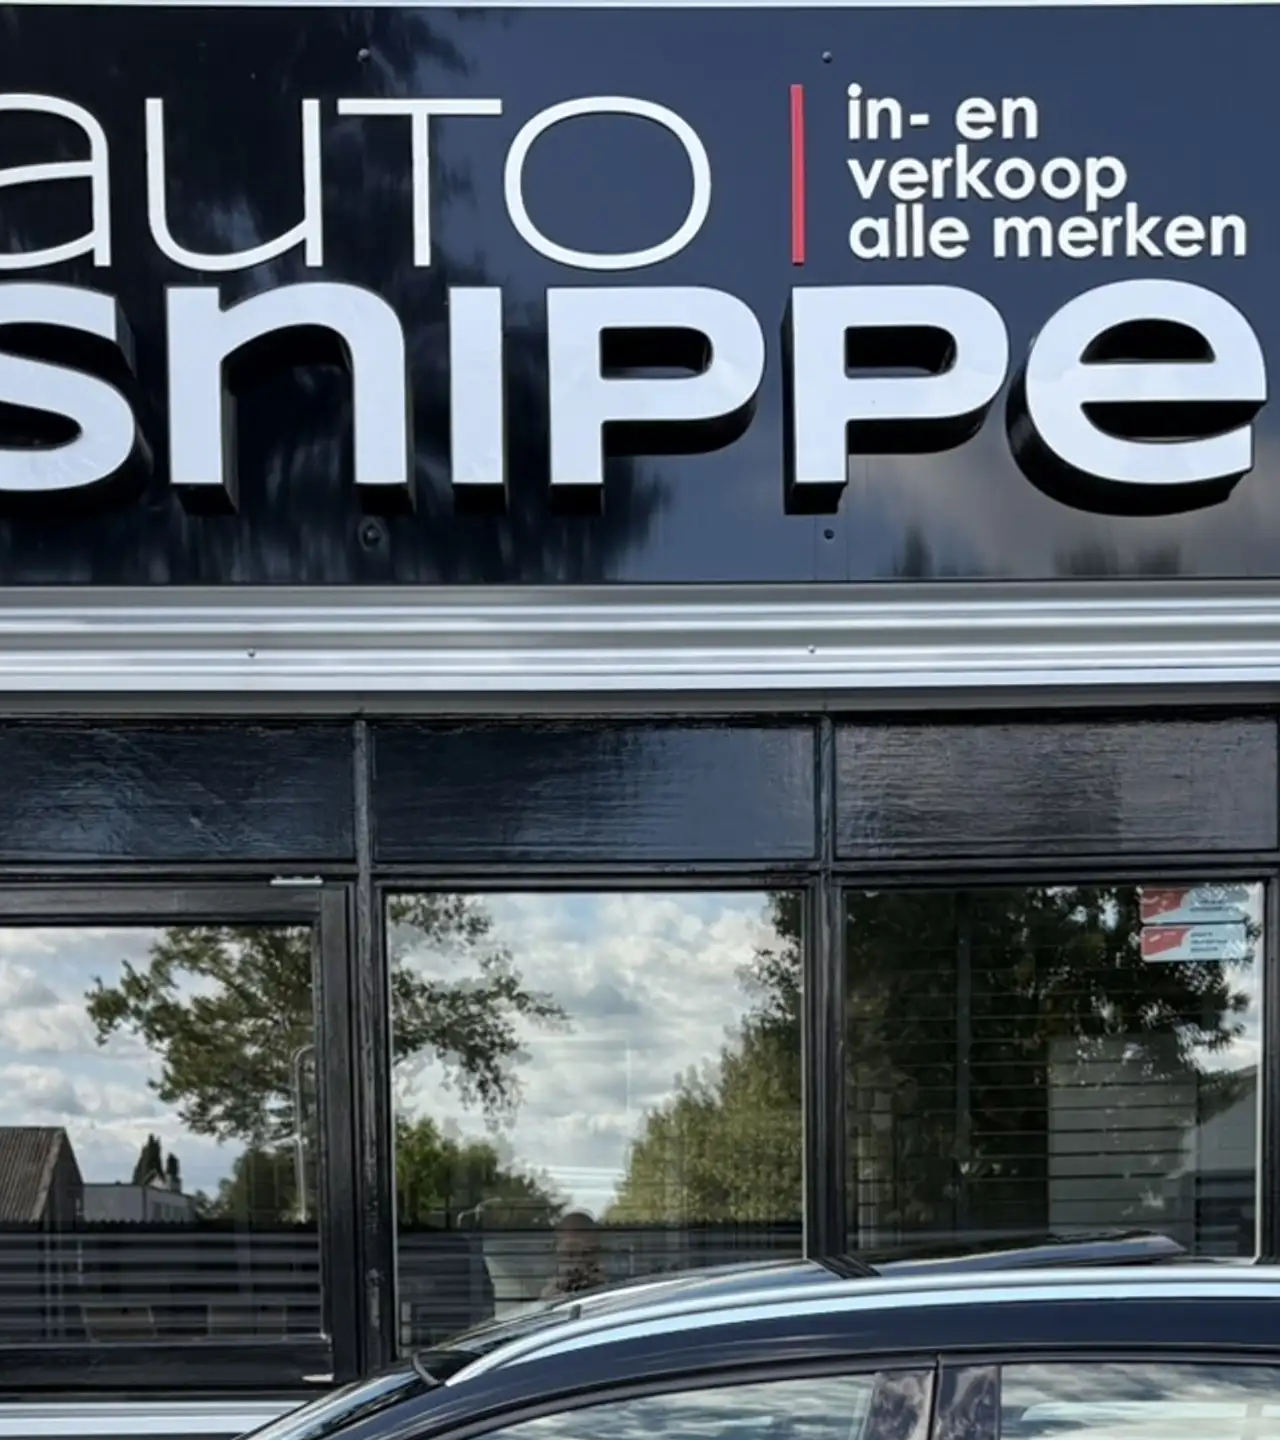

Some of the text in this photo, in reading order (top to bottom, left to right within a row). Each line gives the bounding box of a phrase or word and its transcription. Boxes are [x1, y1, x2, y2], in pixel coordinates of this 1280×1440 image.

[848, 84, 1038, 139] in- en
[847, 156, 1127, 213] verkoop
[849, 202, 1246, 259] alle merken
